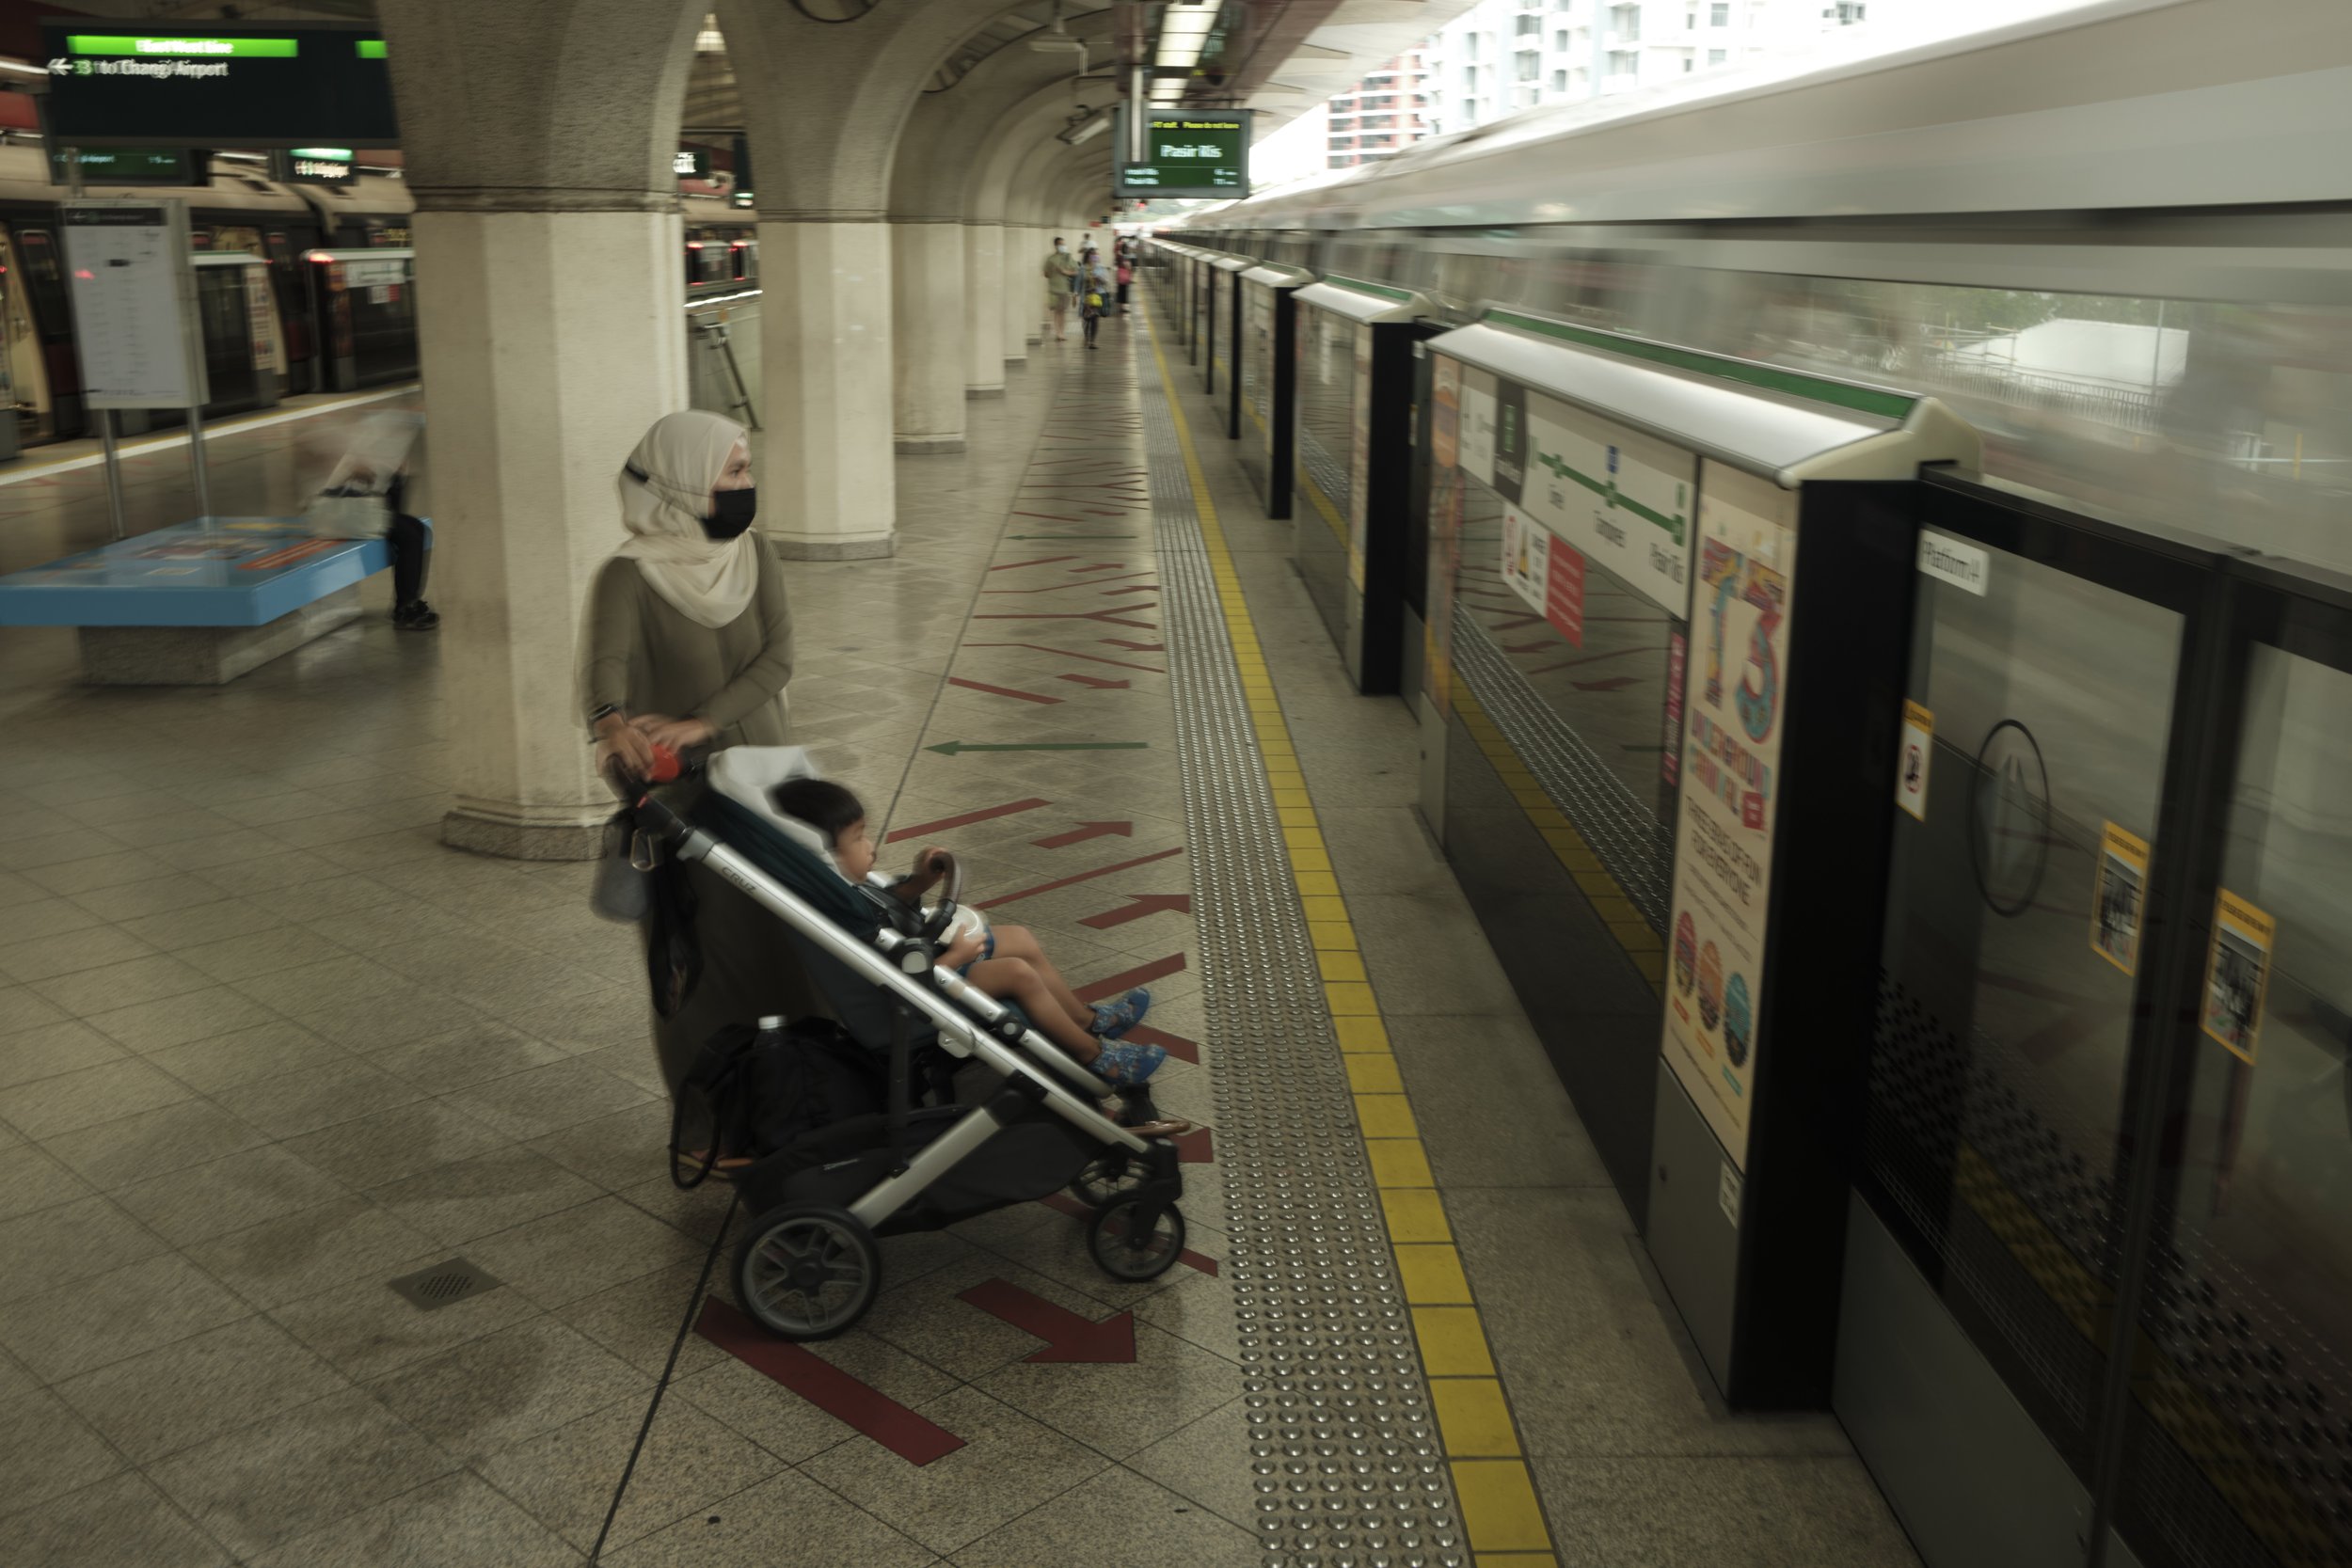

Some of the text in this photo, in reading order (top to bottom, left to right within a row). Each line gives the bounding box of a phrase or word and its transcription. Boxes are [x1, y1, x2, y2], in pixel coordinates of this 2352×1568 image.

[119, 59, 171, 79] Changi
[172, 59, 229, 79] Airport
[1160, 144, 1223, 158] Pasir Ris
[1920, 539, 1971, 582] Platform
[722, 866, 756, 894] CRUZ
